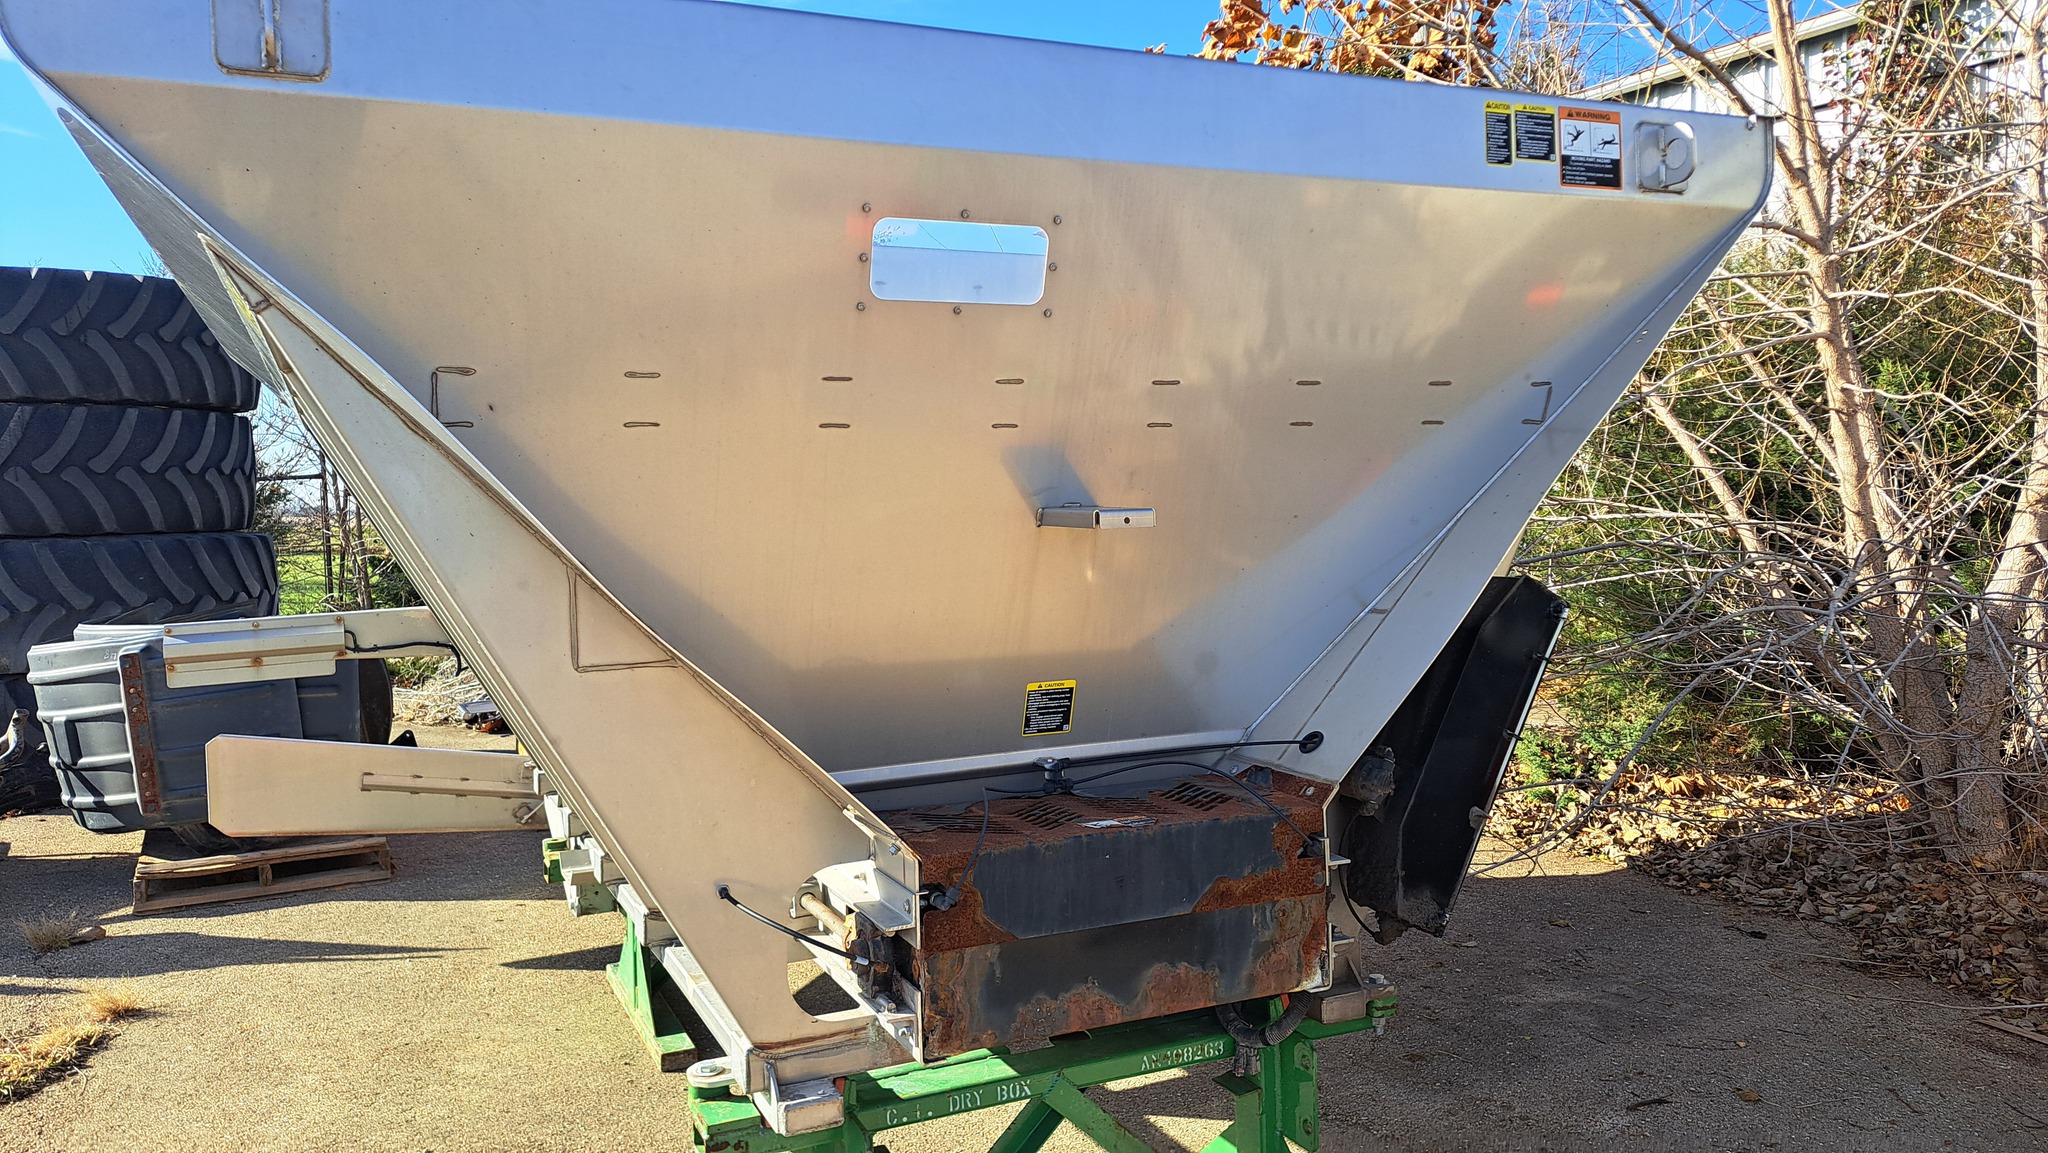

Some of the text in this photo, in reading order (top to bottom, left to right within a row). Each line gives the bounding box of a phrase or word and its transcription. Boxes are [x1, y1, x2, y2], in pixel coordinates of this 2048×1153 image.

[1491, 102, 1510, 110] CAUTION
[1574, 110, 1611, 121] WARNING
[949, 1089, 983, 1112] DRY
[997, 1079, 1032, 1102] BOX
